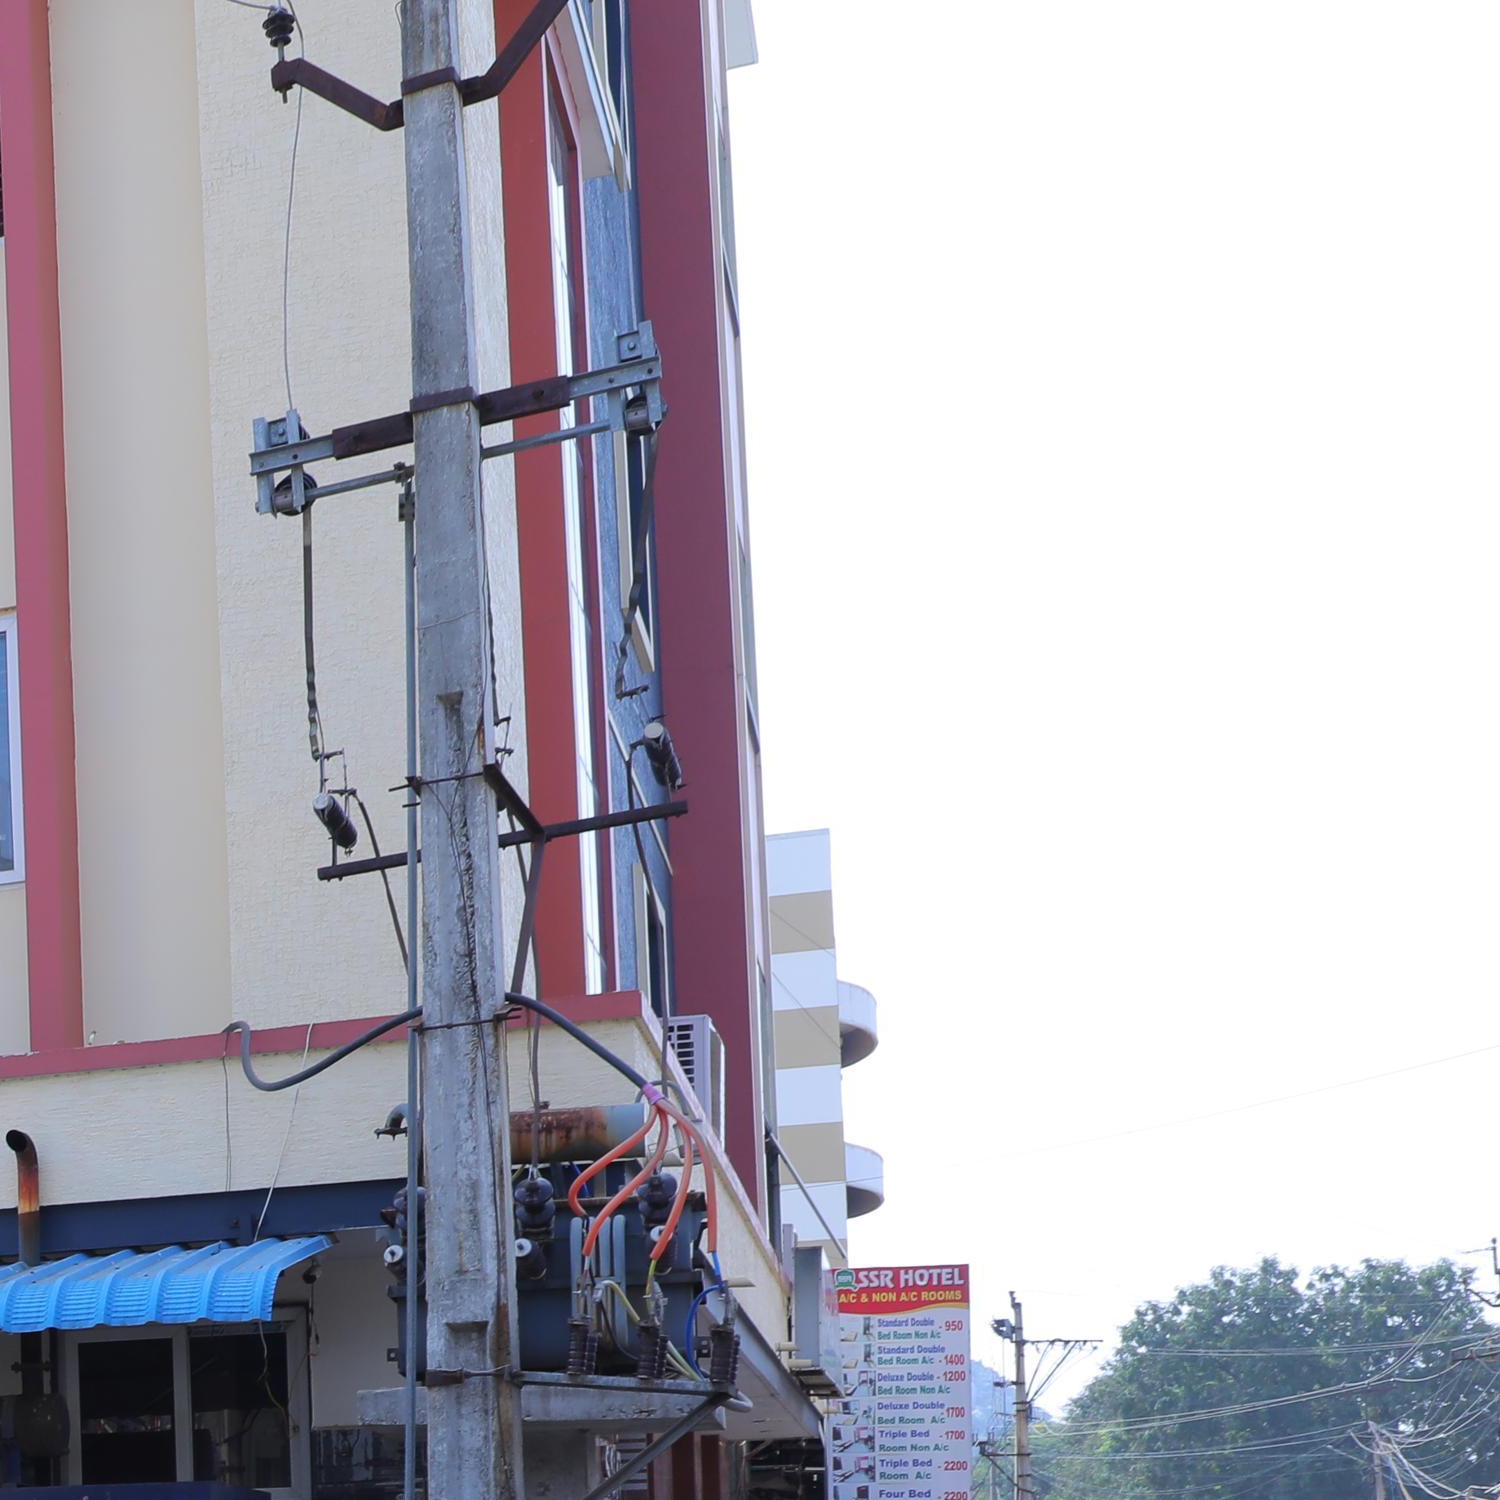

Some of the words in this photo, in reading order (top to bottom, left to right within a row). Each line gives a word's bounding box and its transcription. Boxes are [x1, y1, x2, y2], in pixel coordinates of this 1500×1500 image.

[858, 1270, 894, 1288] SSR
[900, 1268, 965, 1288] HOTEL
[839, 1293, 857, 1303] A/C
[860, 1293, 869, 1303] &
[872, 1292, 896, 1302] NON
[899, 1291, 918, 1302] A/C
[921, 1290, 962, 1301] ROOMS
[877, 1318, 910, 1328] Standard
[911, 1318, 935, 1327] Double
[878, 1331, 892, 1340] Bed
[893, 1331, 913, 1340] Room
[914, 1331, 929, 1340] Non
[877, 1345, 915, 1355] Standard
[917, 1345, 946, 1354] Double
[878, 1356, 893, 1366] Bed
[896, 1356, 920, 1365] Room
[943, 1354, 965, 1366] 1400
[878, 1372, 905, 1382] Deluxe
[907, 1372, 935, 1381] Double
[943, 1371, 966, 1382] 1200
[878, 1386, 893, 1396] Bed
[896, 1386, 918, 1395] Room
[920, 1386, 936, 1395] Non
[877, 1401, 910, 1411] Deluxe
[912, 1401, 945, 1410] Double
[945, 1406, 966, 1418] 1700
[878, 1416, 896, 1425] Bed
[899, 1416, 925, 1425] Room
[879, 1430, 907, 1440] Triple
[911, 1429, 930, 1438] Bed
[945, 1430, 966, 1440] 1700
[879, 1443, 907, 1452] Room
[910, 1443, 931, 1452] Non
[880, 1459, 910, 1470] Triple
[912, 1459, 933, 1468] Bed
[943, 1460, 968, 1471] 2200
[880, 1471, 909, 1480] Room
[879, 1489, 906, 1499] Four
[908, 1489, 932, 1498] Bed
